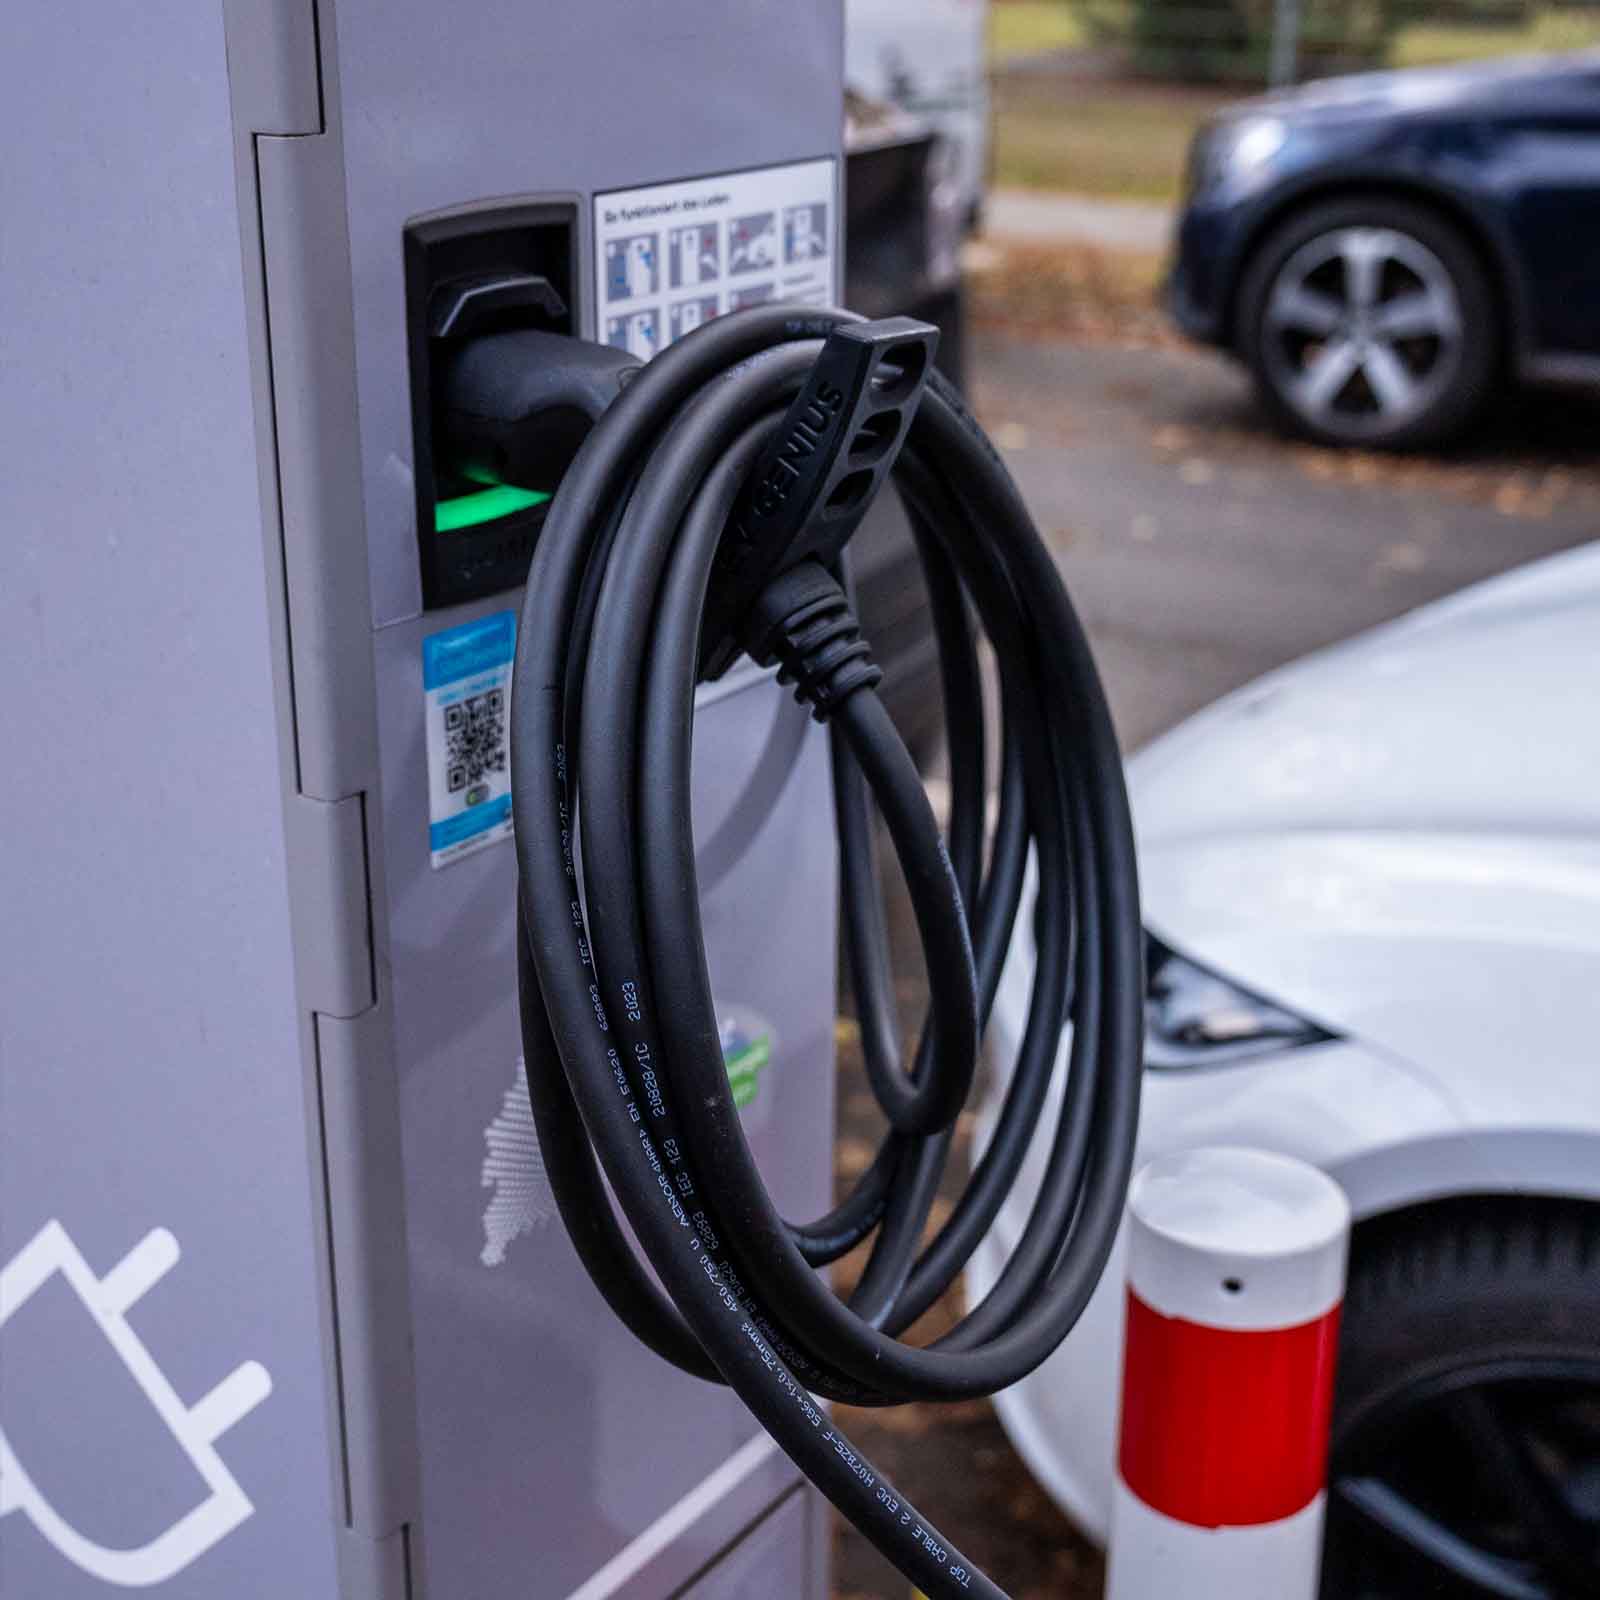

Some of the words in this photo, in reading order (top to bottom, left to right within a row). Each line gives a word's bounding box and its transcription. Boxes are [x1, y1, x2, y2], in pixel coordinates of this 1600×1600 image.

[622, 981, 641, 1022] 2023
[607, 1048, 631, 1096] 50620
[626, 1102, 641, 1123] EN
[663, 1137, 682, 1166] 123
[675, 1171, 695, 1198] IEC
[699, 1254, 738, 1312] 450/750
[900, 1511, 912, 1525] 2
[911, 1524, 948, 1564] CABLE
[949, 1565, 972, 1589] TOP
